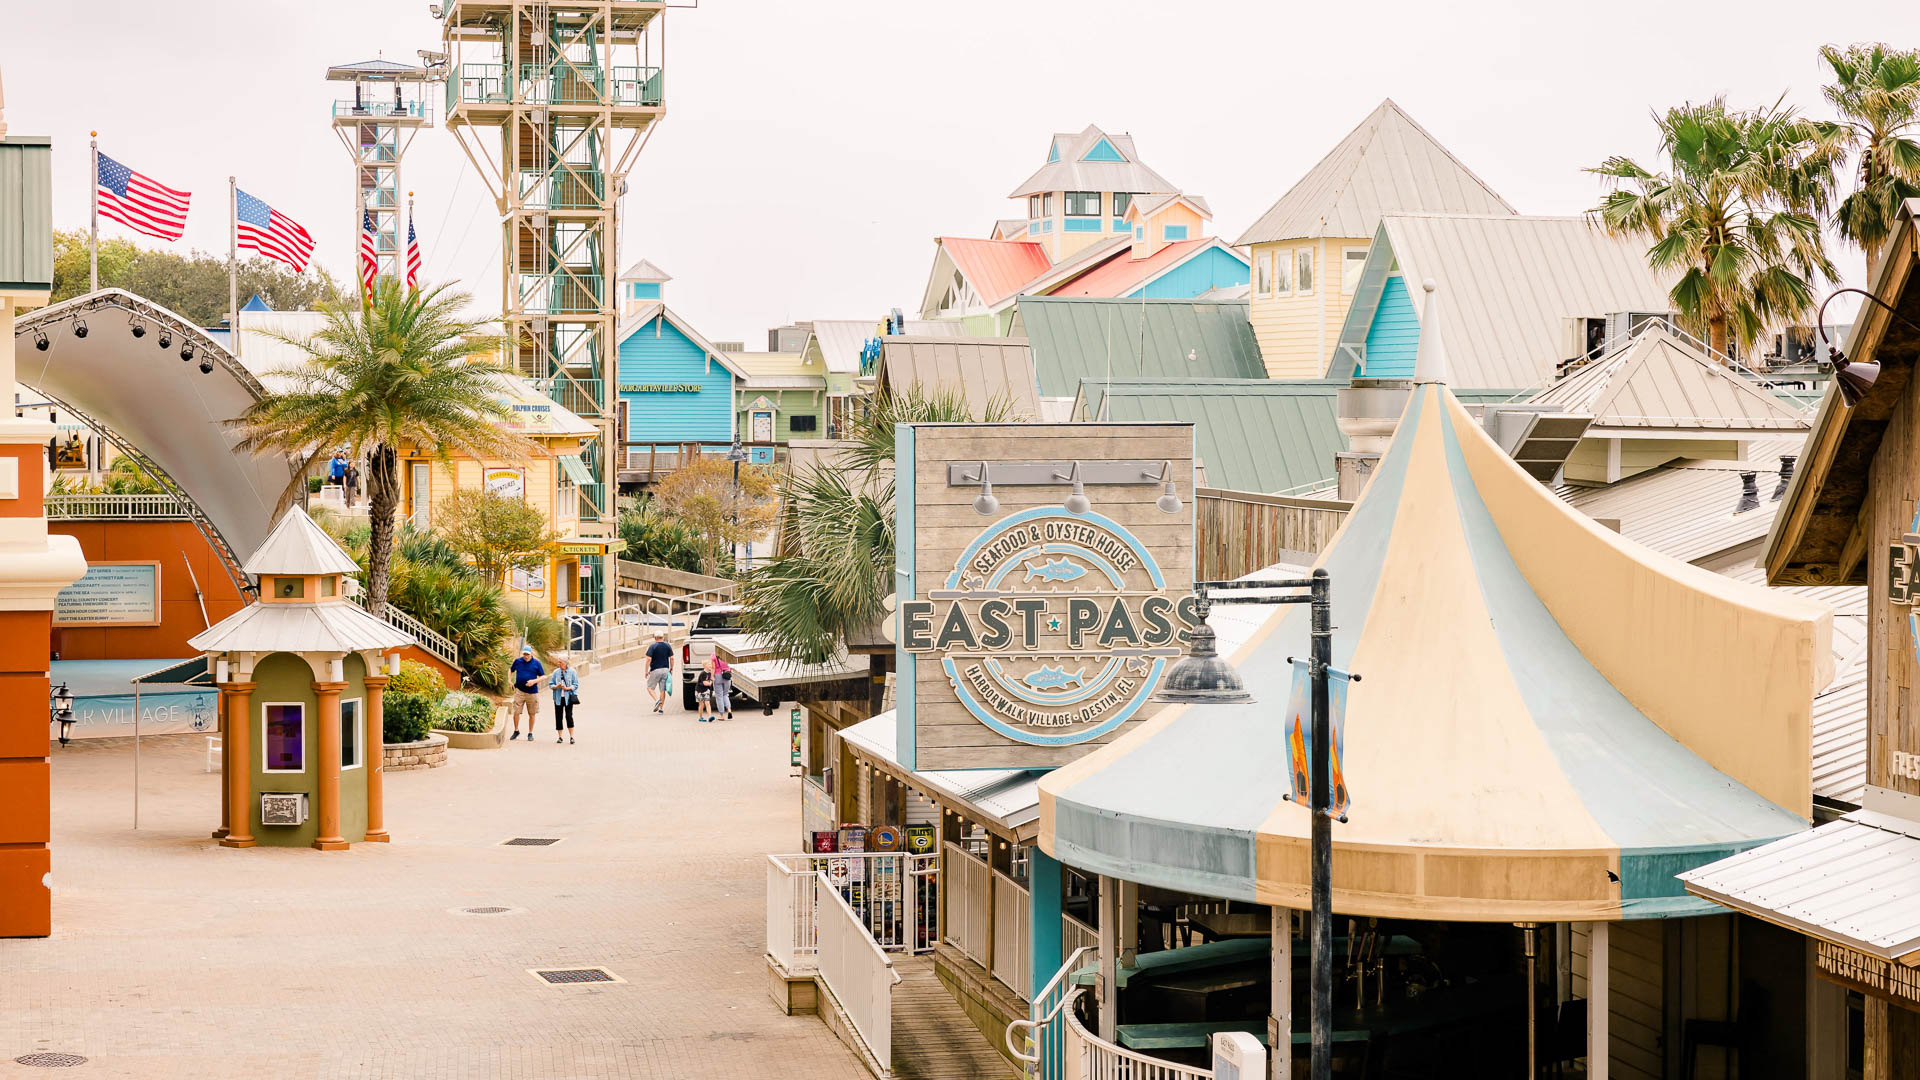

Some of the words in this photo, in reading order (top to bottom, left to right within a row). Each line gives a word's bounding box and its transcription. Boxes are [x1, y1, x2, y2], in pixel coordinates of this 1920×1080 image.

[619, 384, 677, 392] MARGARITAVILLE
[678, 383, 702, 392] STORE
[975, 530, 1027, 573] SEAFOOD
[1030, 525, 1041, 541] &
[1046, 523, 1096, 546] OYSTER
[1095, 534, 1135, 572] HOUSE
[902, 600, 1048, 651] EAST
[1067, 596, 1198, 649] PASS
[101, 705, 180, 725] VILLAGE
[967, 665, 1025, 721] HARBORWALK
[1028, 711, 1071, 726] VILLAGE
[1081, 692, 1123, 722] DESTIN,
[1117, 678, 1134, 695] FL
[1818, 941, 1887, 990] WATERFRONT
